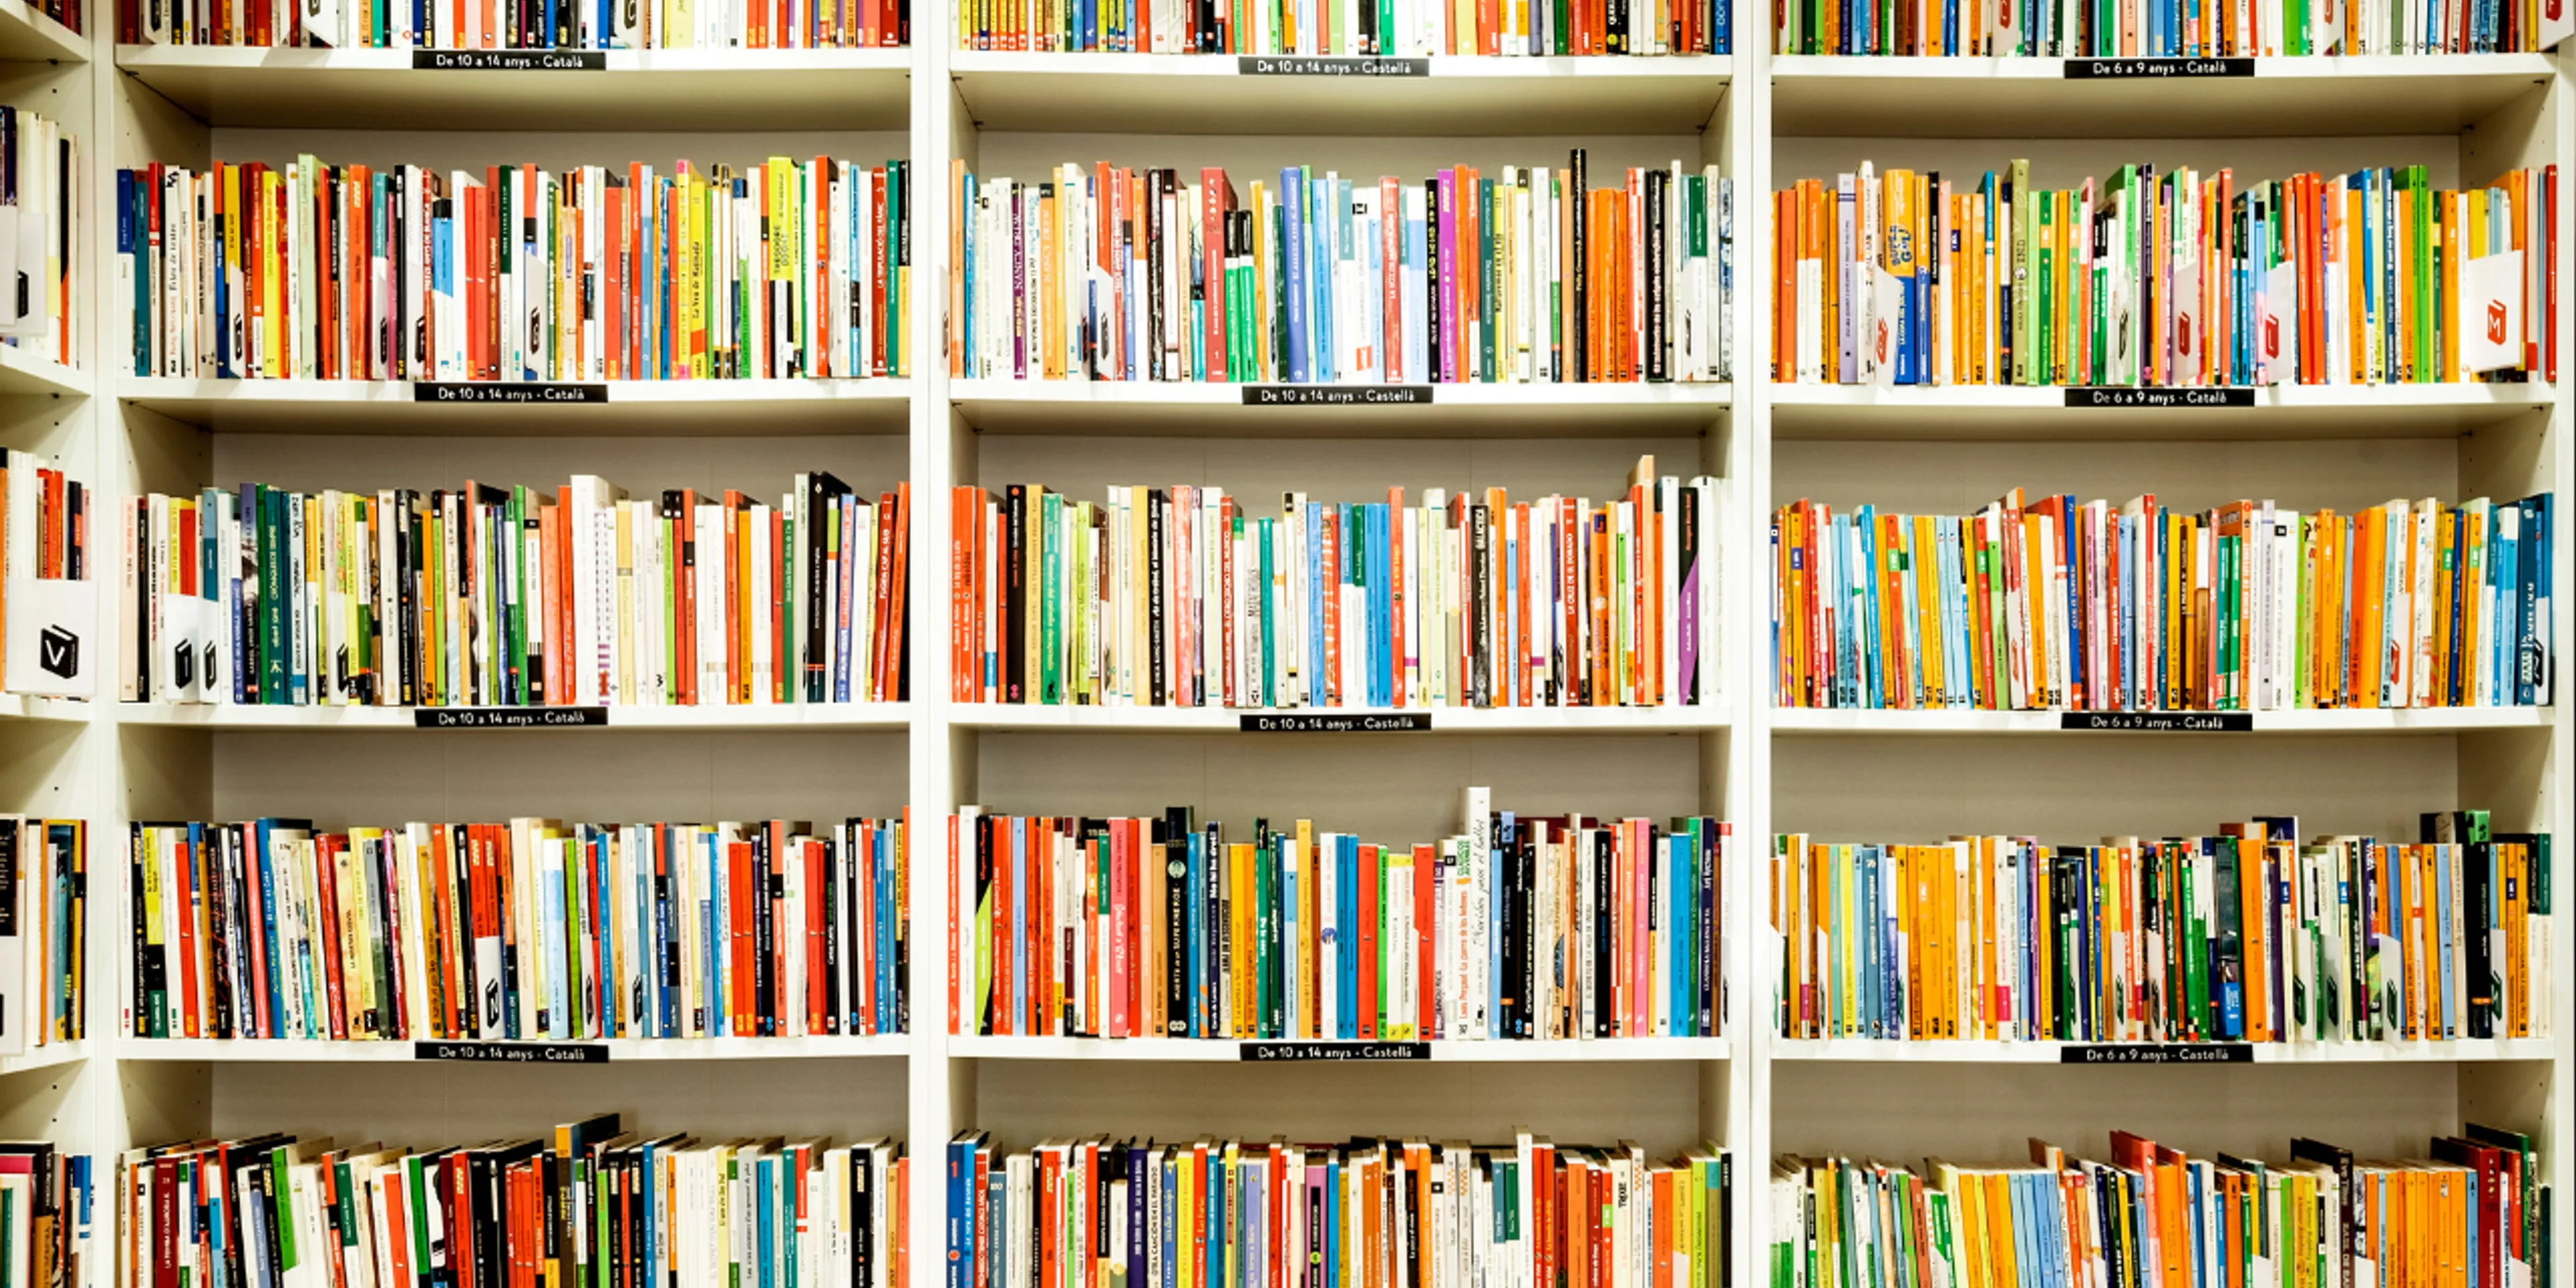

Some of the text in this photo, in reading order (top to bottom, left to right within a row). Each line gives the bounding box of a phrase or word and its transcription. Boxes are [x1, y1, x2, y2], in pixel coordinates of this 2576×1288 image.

[436, 54, 583, 70] De 10 a 14 anys Català
[1257, 60, 1411, 76] De 10 a 14 anys Castellà
[2093, 62, 2226, 77] De 6 a 9 anys Català
[438, 387, 585, 402] De 10 a 14 anys Català
[1261, 390, 1278, 401] De
[1282, 390, 1295, 401] 10
[1310, 390, 1324, 401] 14
[1328, 392, 1354, 405] anys
[1366, 390, 1414, 402] Castellà
[2093, 391, 2226, 406] De 6 a 9 anys Català
[438, 711, 584, 727] De 10 a 14 anys Català
[1259, 716, 1414, 732] De 10 a 14 anys Castellà
[2091, 716, 2223, 731] De 6 a 9 anys Català
[439, 1046, 584, 1061] De 10 a 14 anys Català
[1258, 1046, 1412, 1061] De 10 a 14 anys Castellà
[2086, 1048, 2229, 1064] De 6 a 9 anys Castellà
